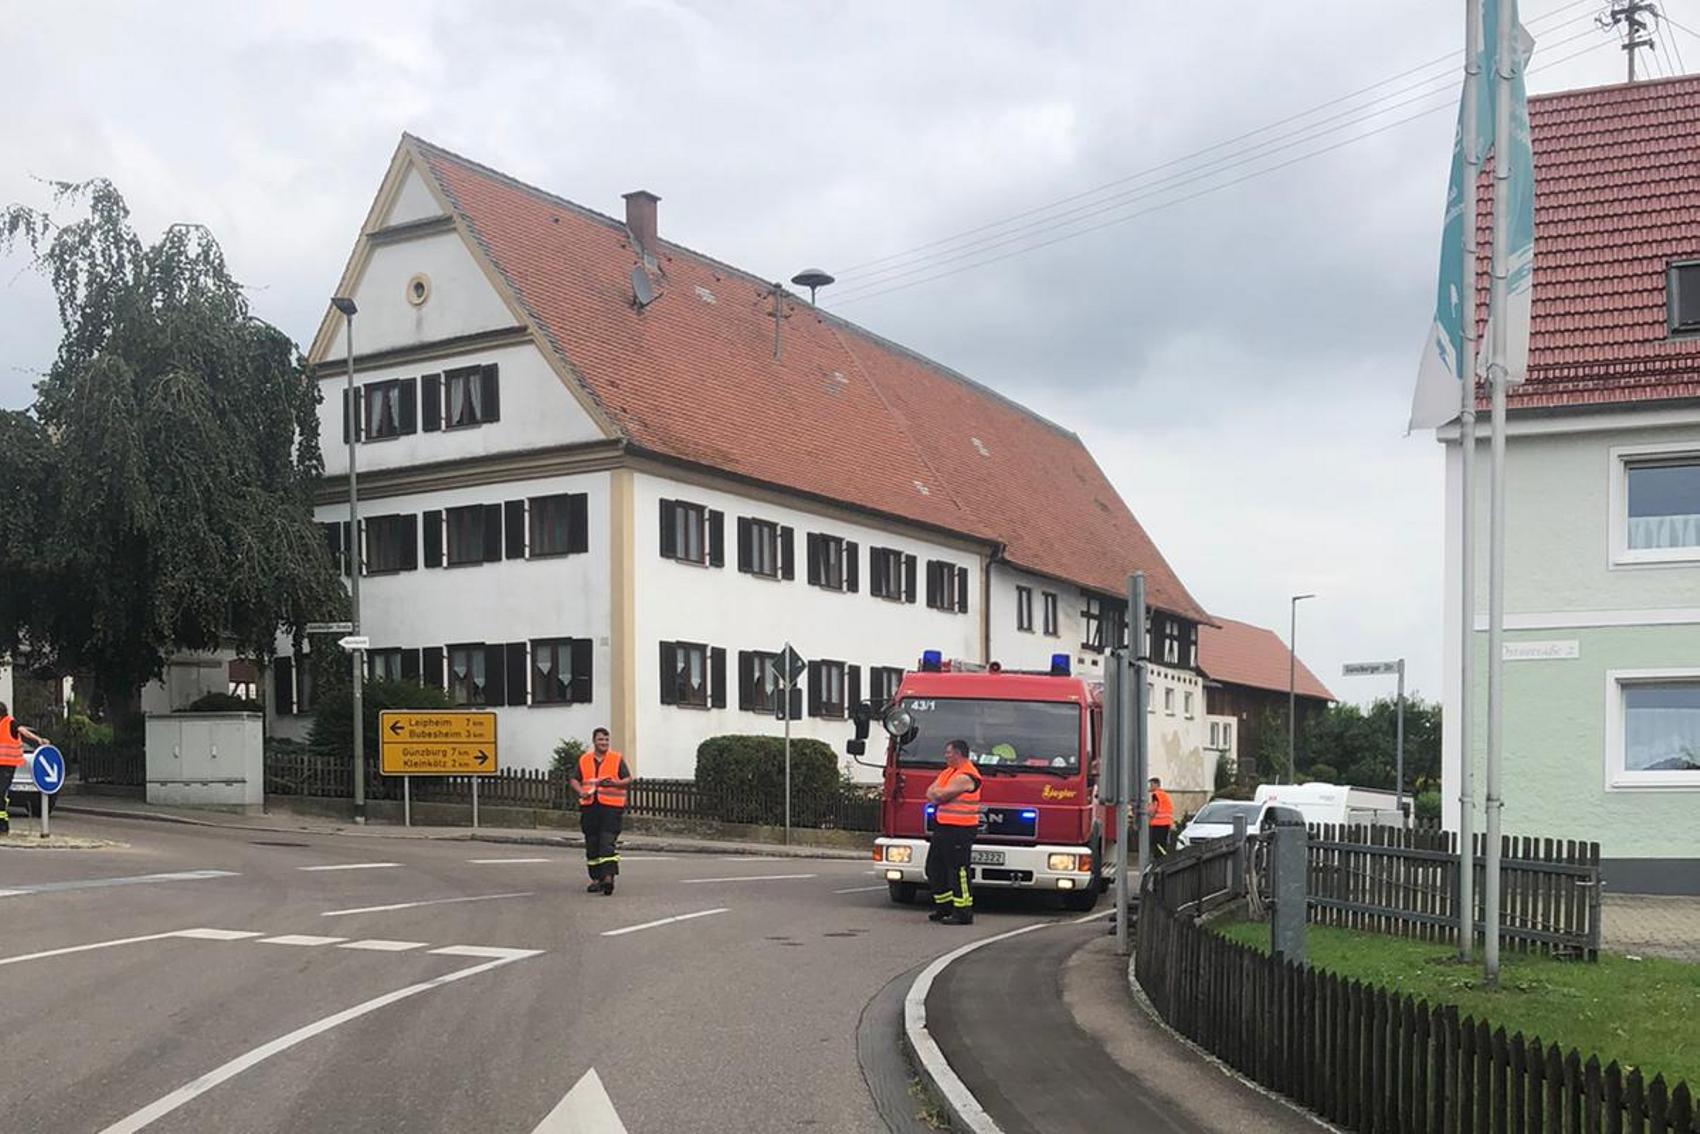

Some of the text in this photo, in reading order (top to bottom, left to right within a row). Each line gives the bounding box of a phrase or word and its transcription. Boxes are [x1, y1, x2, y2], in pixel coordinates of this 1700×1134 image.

[911, 700, 935, 710] 43/1
[409, 717, 484, 728] Leipheim 7 km
[409, 729, 461, 738] Bubesheim
[465, 730, 471, 738] 3
[402, 747, 447, 757] Günzburg
[451, 748, 456, 756] 7
[403, 759, 470, 768] Kleinkötz 2 km
